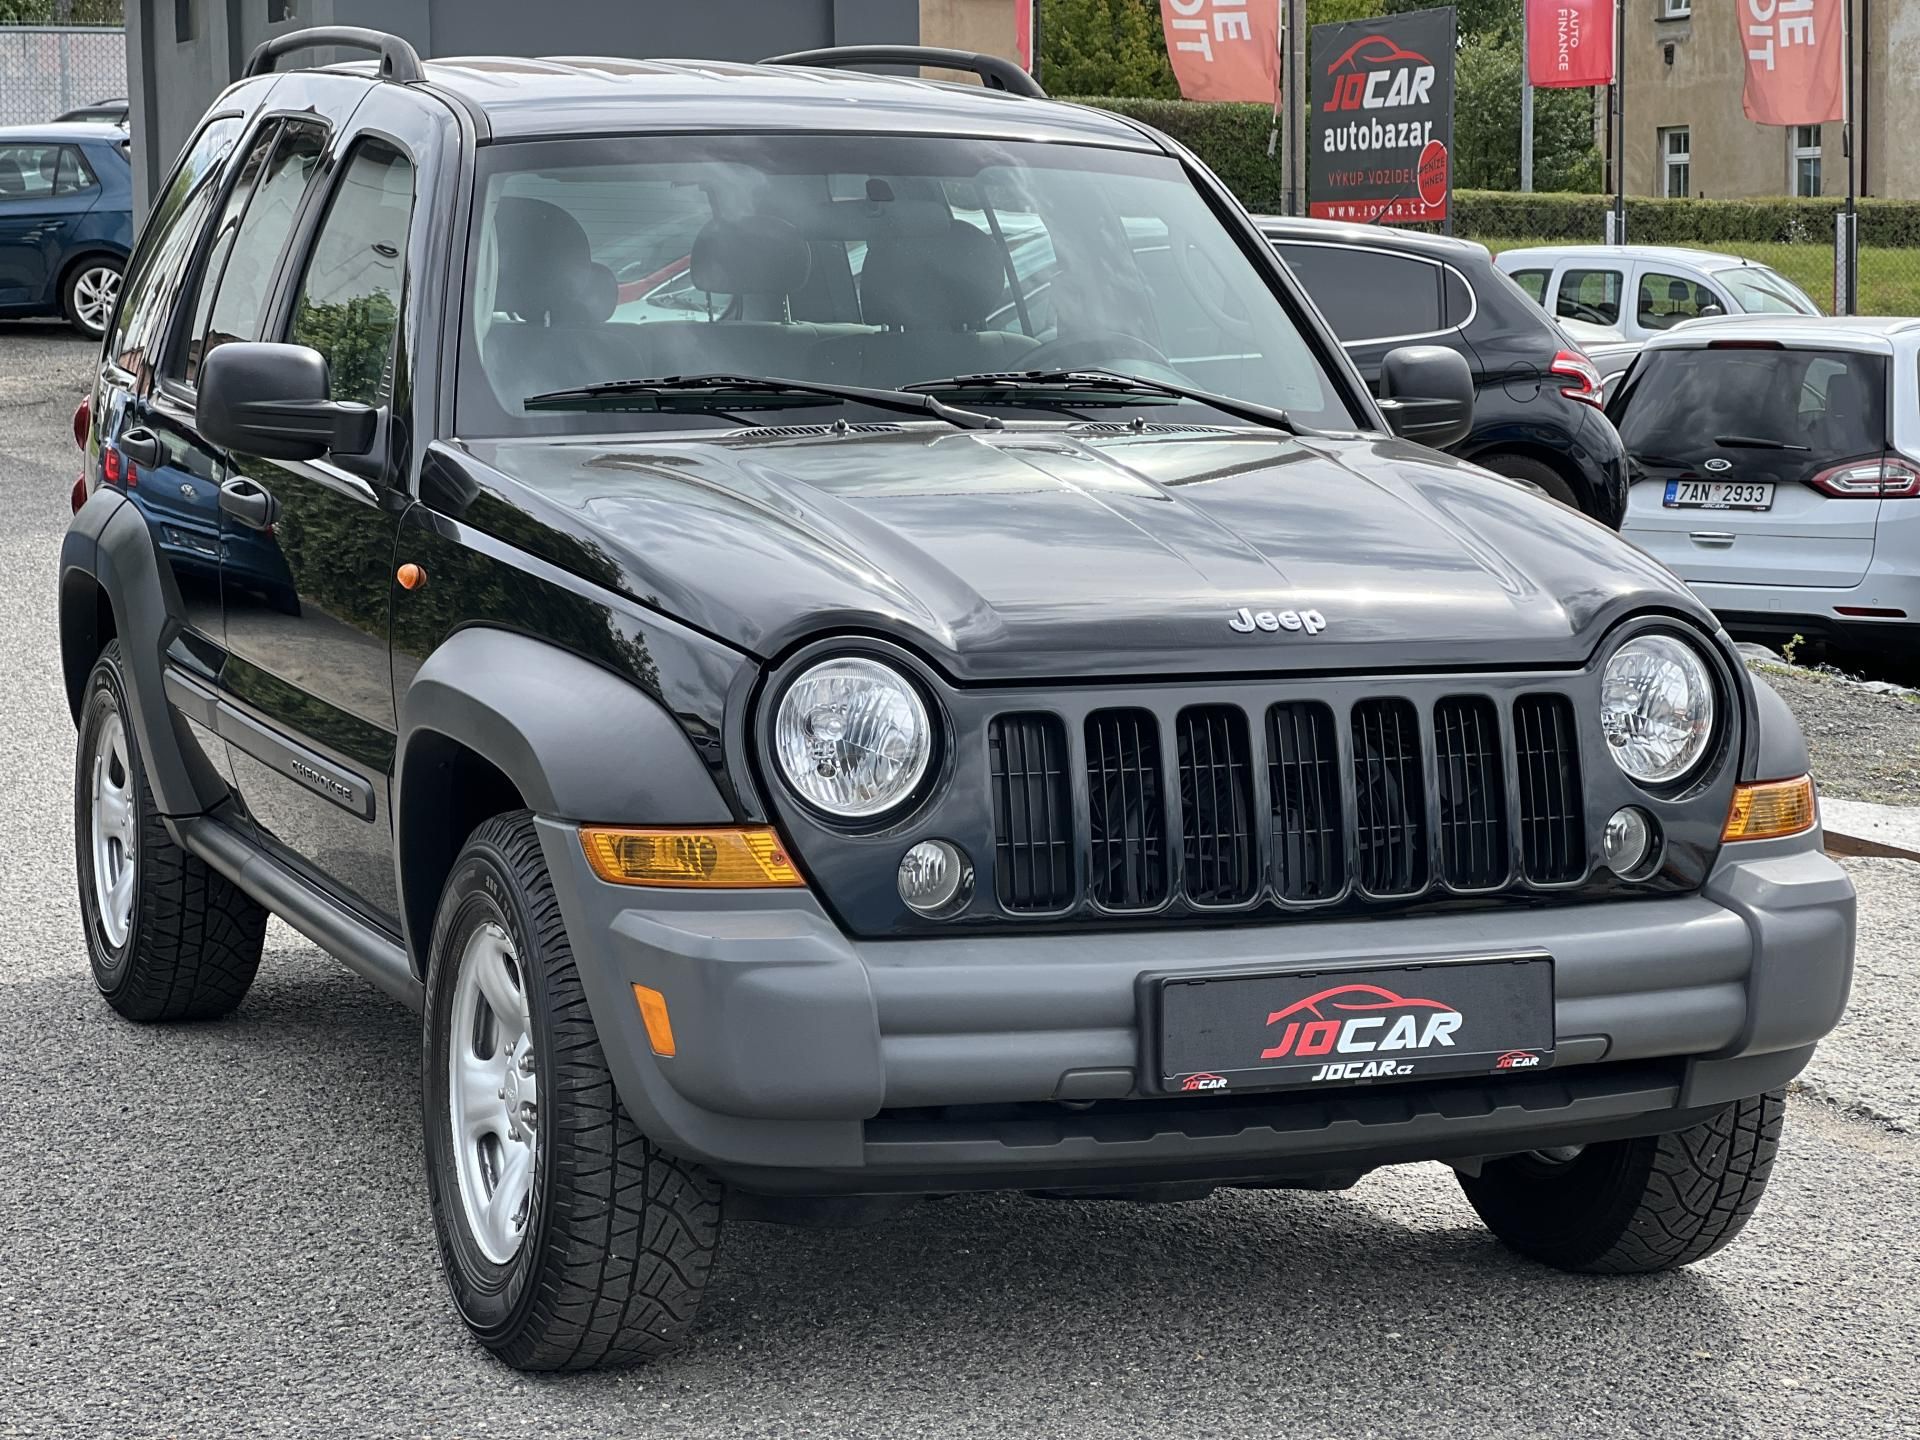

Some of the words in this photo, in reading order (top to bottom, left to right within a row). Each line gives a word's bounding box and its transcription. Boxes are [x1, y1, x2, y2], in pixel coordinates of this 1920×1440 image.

[1558, 9, 1569, 71] FINANCE
[1570, 8, 1579, 48] AUTO
[1323, 65, 1435, 112] JOCAR
[1324, 117, 1433, 153] autobazar
[1368, 168, 1416, 185] VOZIDEL
[1680, 484, 1711, 501] 7AN
[1723, 485, 1765, 503] 2933
[1228, 607, 1327, 636] Jeep
[1260, 1012, 1463, 1059] JOCAR
[1496, 1057, 1540, 1069] JOCAR
[1181, 1079, 1228, 1090] JOCAR
